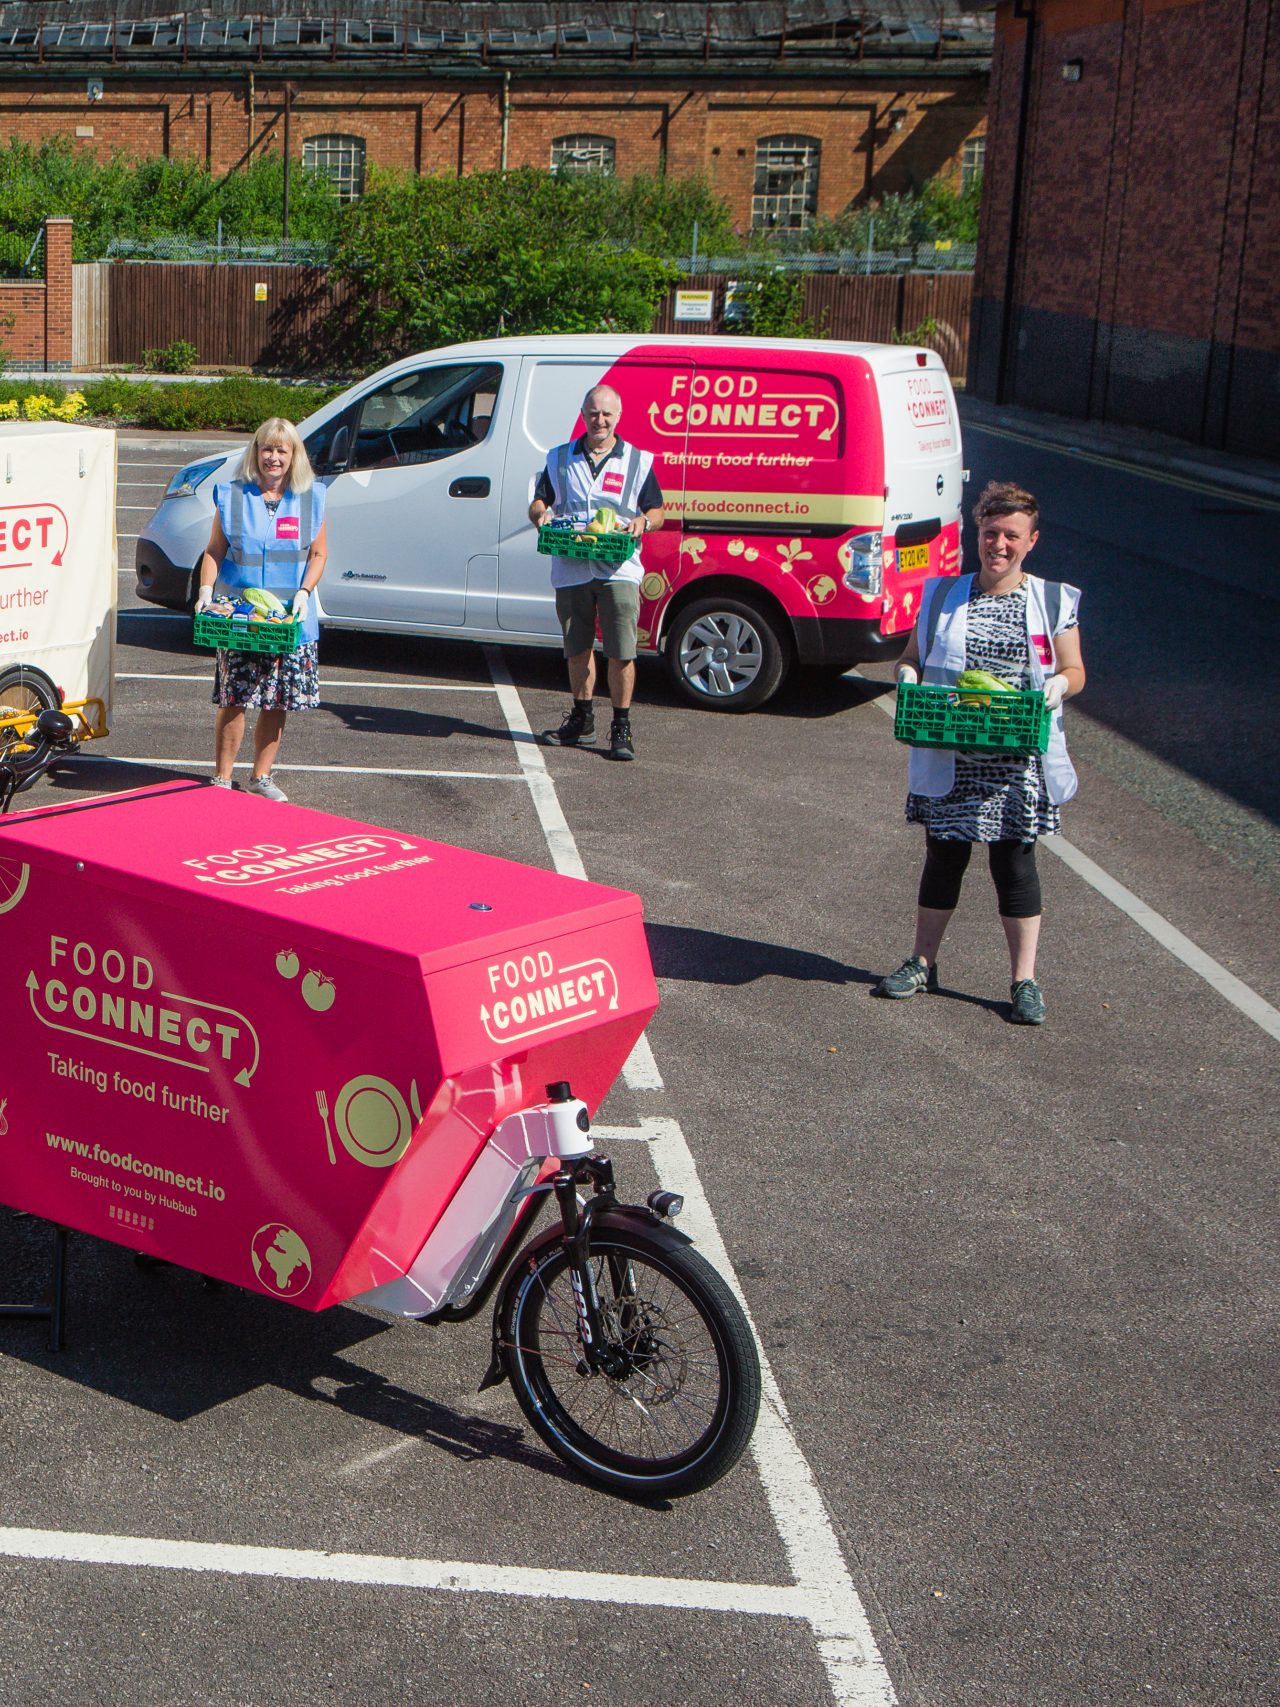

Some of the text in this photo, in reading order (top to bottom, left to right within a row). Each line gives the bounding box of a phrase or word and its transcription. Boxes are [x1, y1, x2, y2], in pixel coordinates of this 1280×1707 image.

[671, 375, 758, 398] FOOD
[663, 403, 824, 427] CONNECT
[912, 399, 948, 418] CONNECT
[662, 451, 814, 469] Taking food further
[661, 499, 810, 514] ww.foodconnect.io
[900, 547, 928, 569] EY20 KPU
[182, 844, 287, 870] FOOD
[216, 838, 387, 881] CONNECT
[274, 855, 436, 895] Taking food further
[50, 935, 154, 990] FOOD
[488, 951, 554, 993] FOOD
[45, 979, 240, 1060] CONNECT
[493, 970, 606, 1029] CONNECT
[47, 1052, 230, 1124] Taking food further
[45, 1132, 226, 1202] www.foodconnect.io
[70, 1167, 198, 1217] Brought to you by Hubbub
